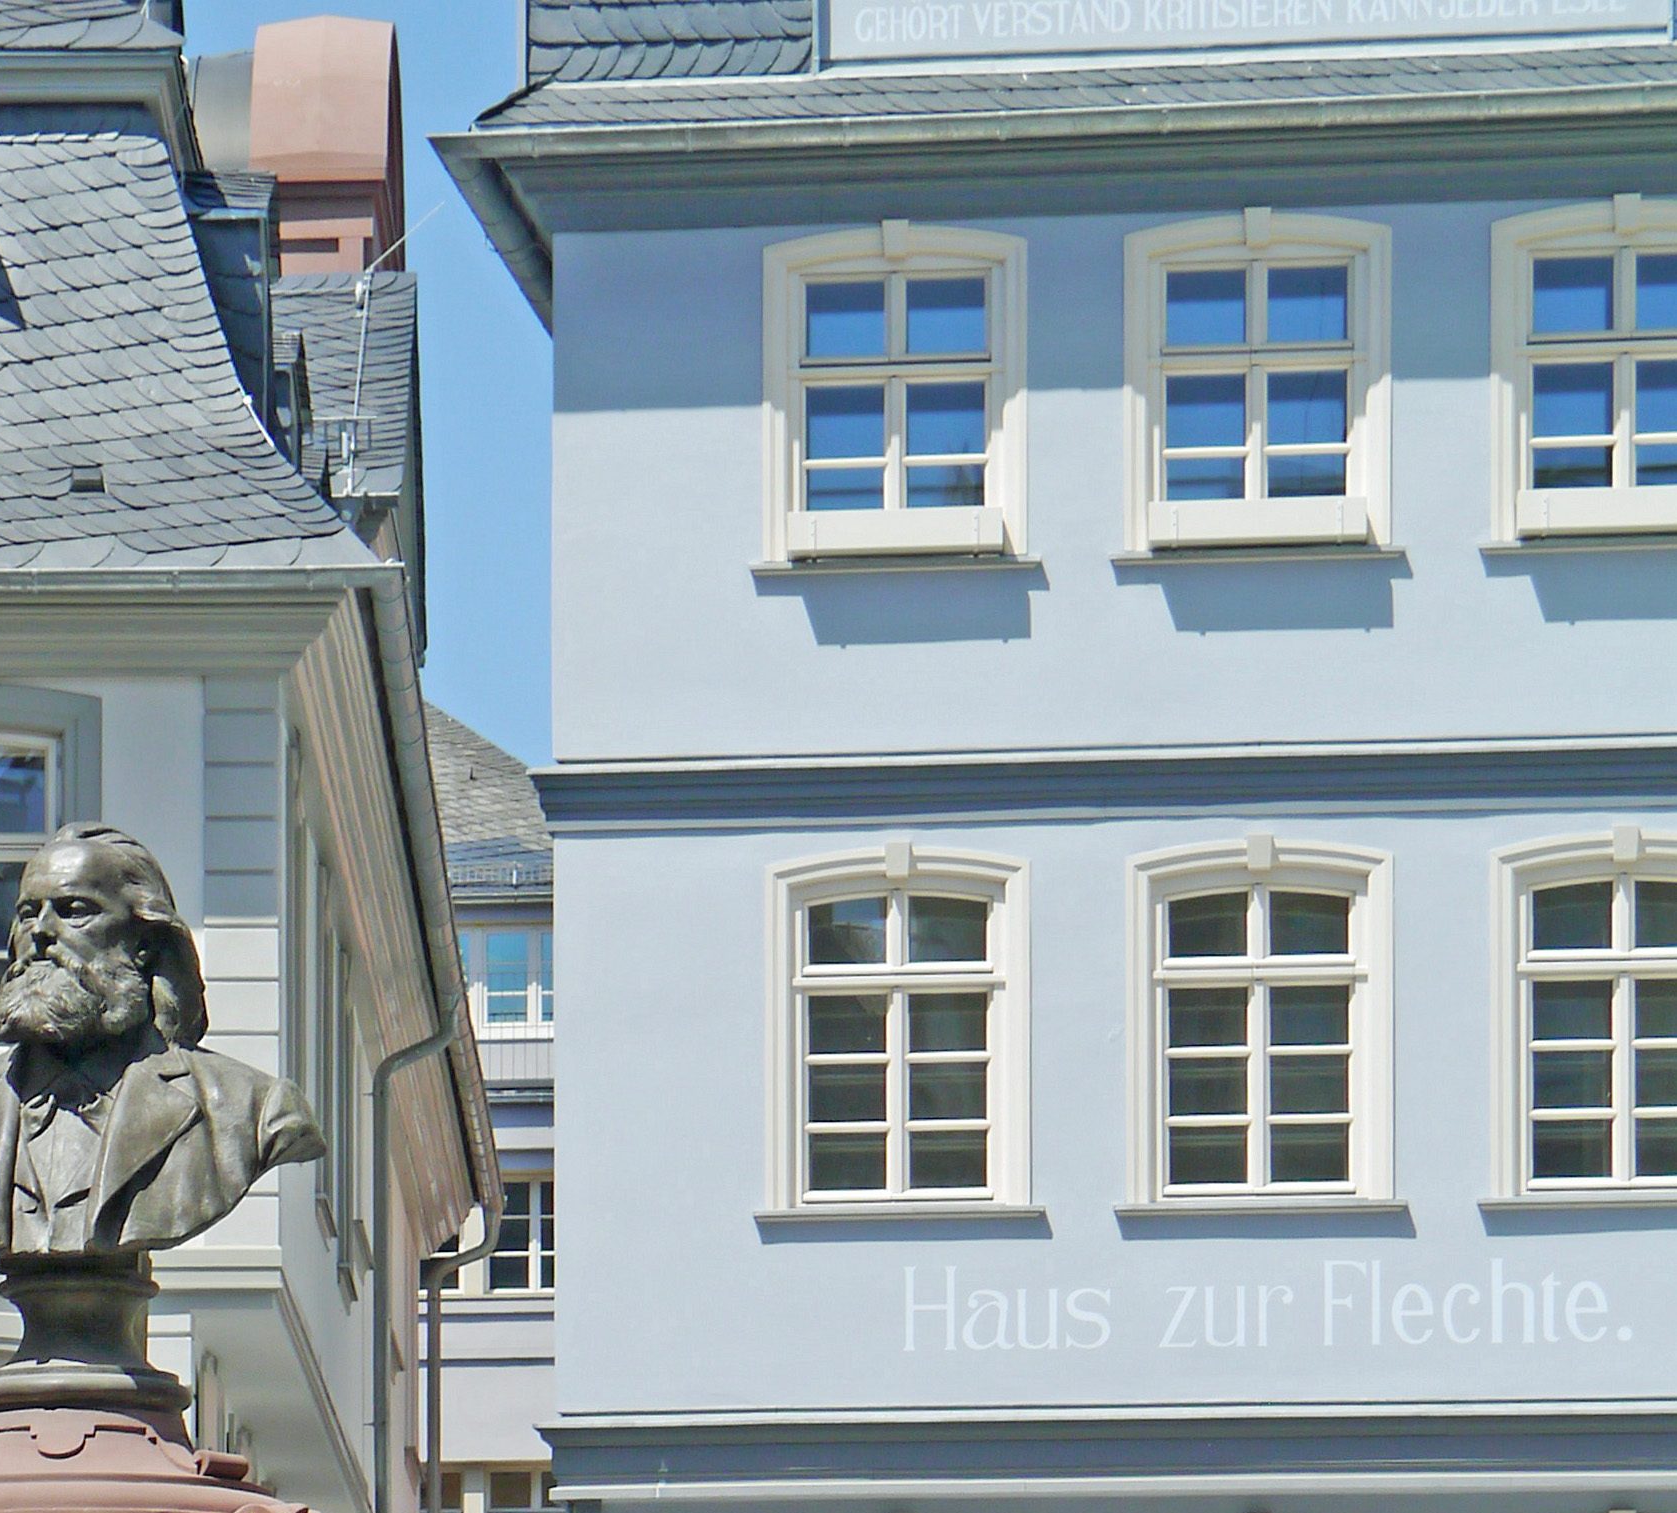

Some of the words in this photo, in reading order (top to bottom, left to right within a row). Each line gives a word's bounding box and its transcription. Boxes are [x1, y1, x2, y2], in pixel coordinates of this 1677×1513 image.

[854, 0, 964, 42] GEHÖRT
[973, 0, 1132, 38] VERSTAND
[1143, 0, 1332, 31] KRITISIEREN
[1347, 0, 1435, 25] KANN
[901, 1265, 1112, 1352] Haus
[1158, 1283, 1295, 1349] zur
[1322, 1257, 1635, 1346] Flechte.
